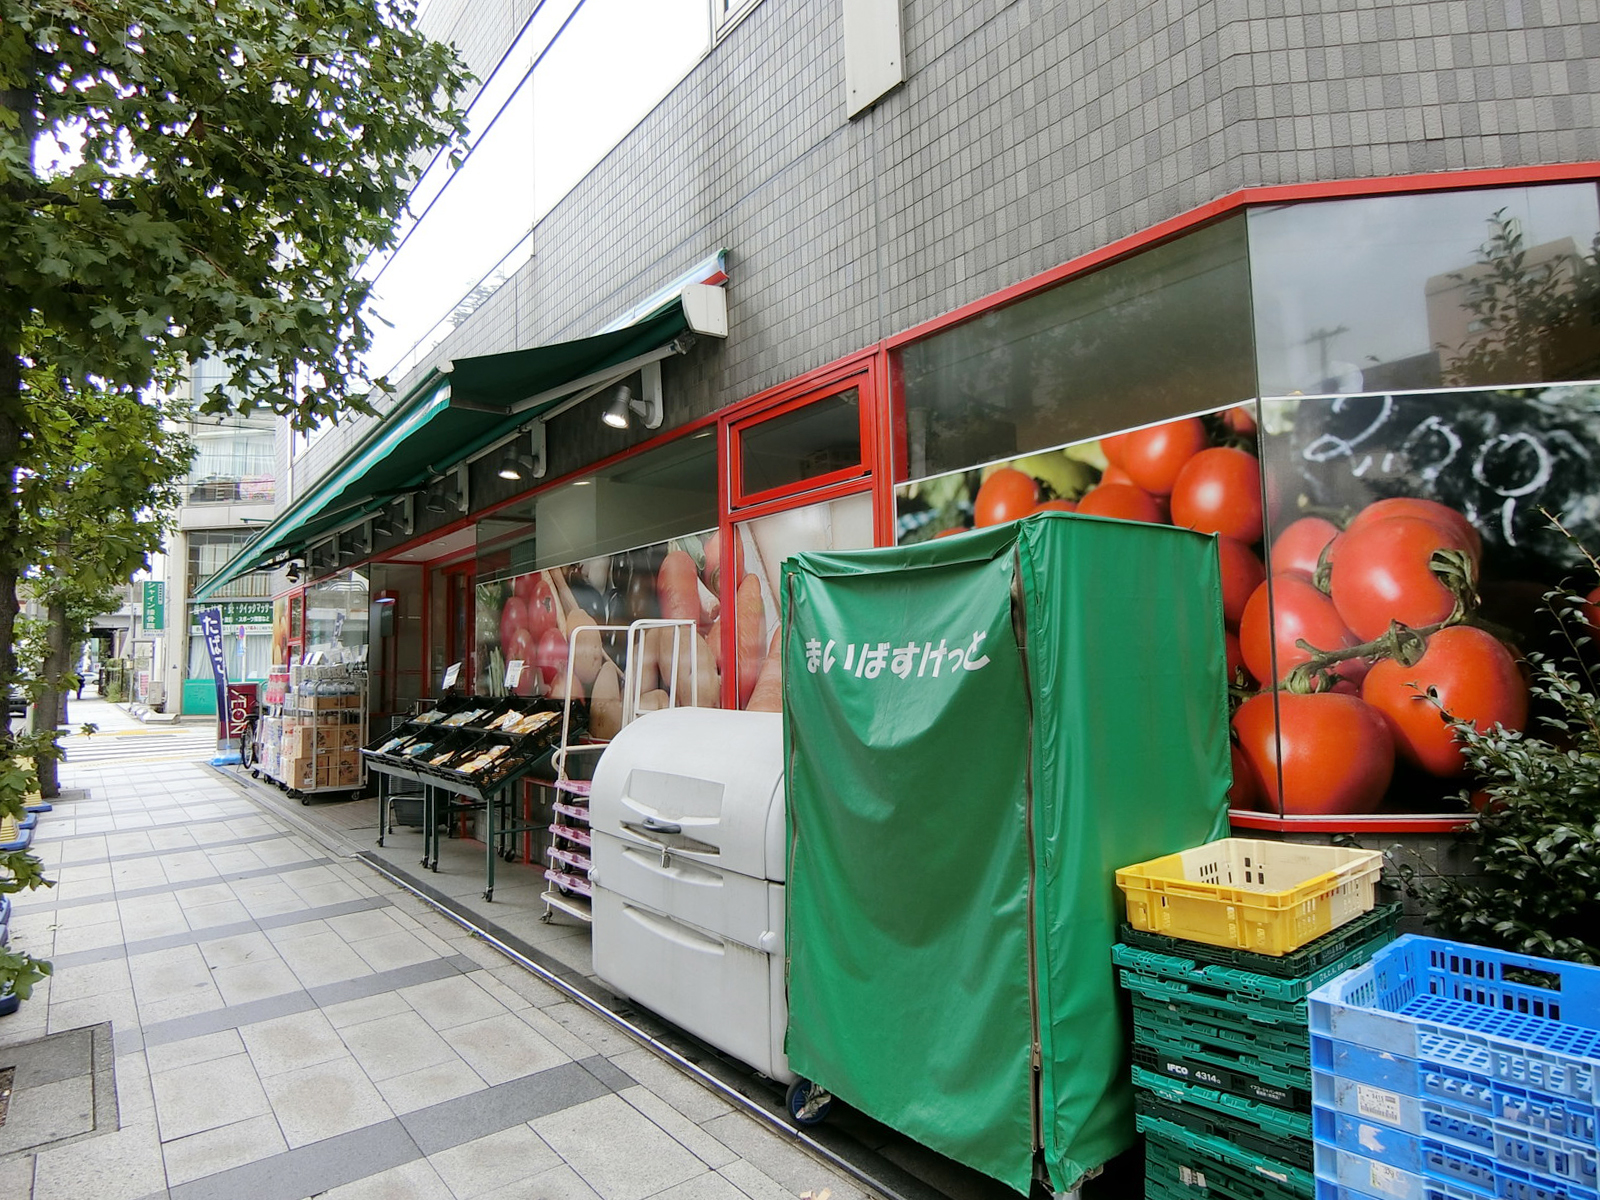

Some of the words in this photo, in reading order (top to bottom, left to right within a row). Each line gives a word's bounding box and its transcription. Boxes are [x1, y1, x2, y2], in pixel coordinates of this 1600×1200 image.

[203, 616, 225, 674] たばこ
[805, 630, 991, 679] まいばすけっと
[1167, 1062, 1188, 1075] IFCO
